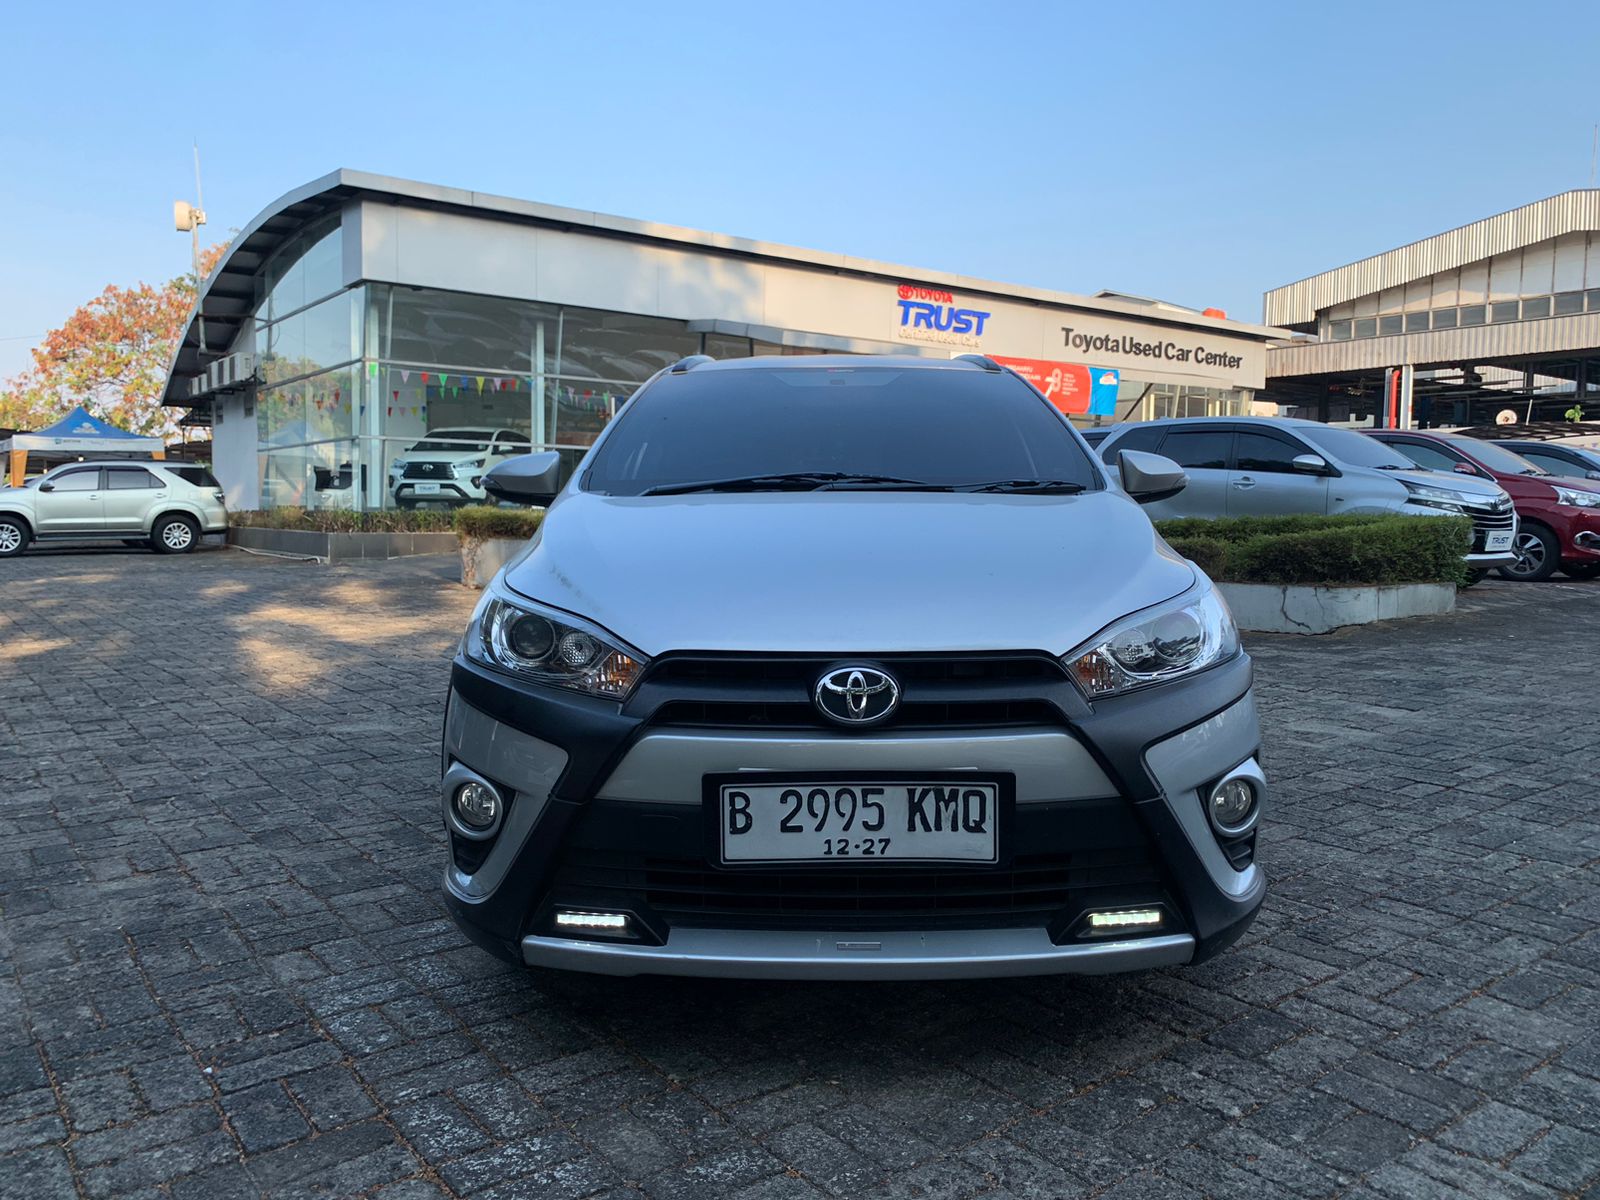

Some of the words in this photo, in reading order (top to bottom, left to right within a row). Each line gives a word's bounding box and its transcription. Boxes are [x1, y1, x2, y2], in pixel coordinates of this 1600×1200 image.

[913, 286, 953, 304] TOYOTA
[897, 299, 991, 336] TRUST
[1061, 327, 1120, 353] Toyota
[1122, 335, 1162, 359] Used
[1164, 342, 1192, 362] Car
[1194, 346, 1243, 369] Center
[728, 791, 752, 835] B
[779, 788, 885, 833] 2995
[906, 786, 987, 833] KMQ
